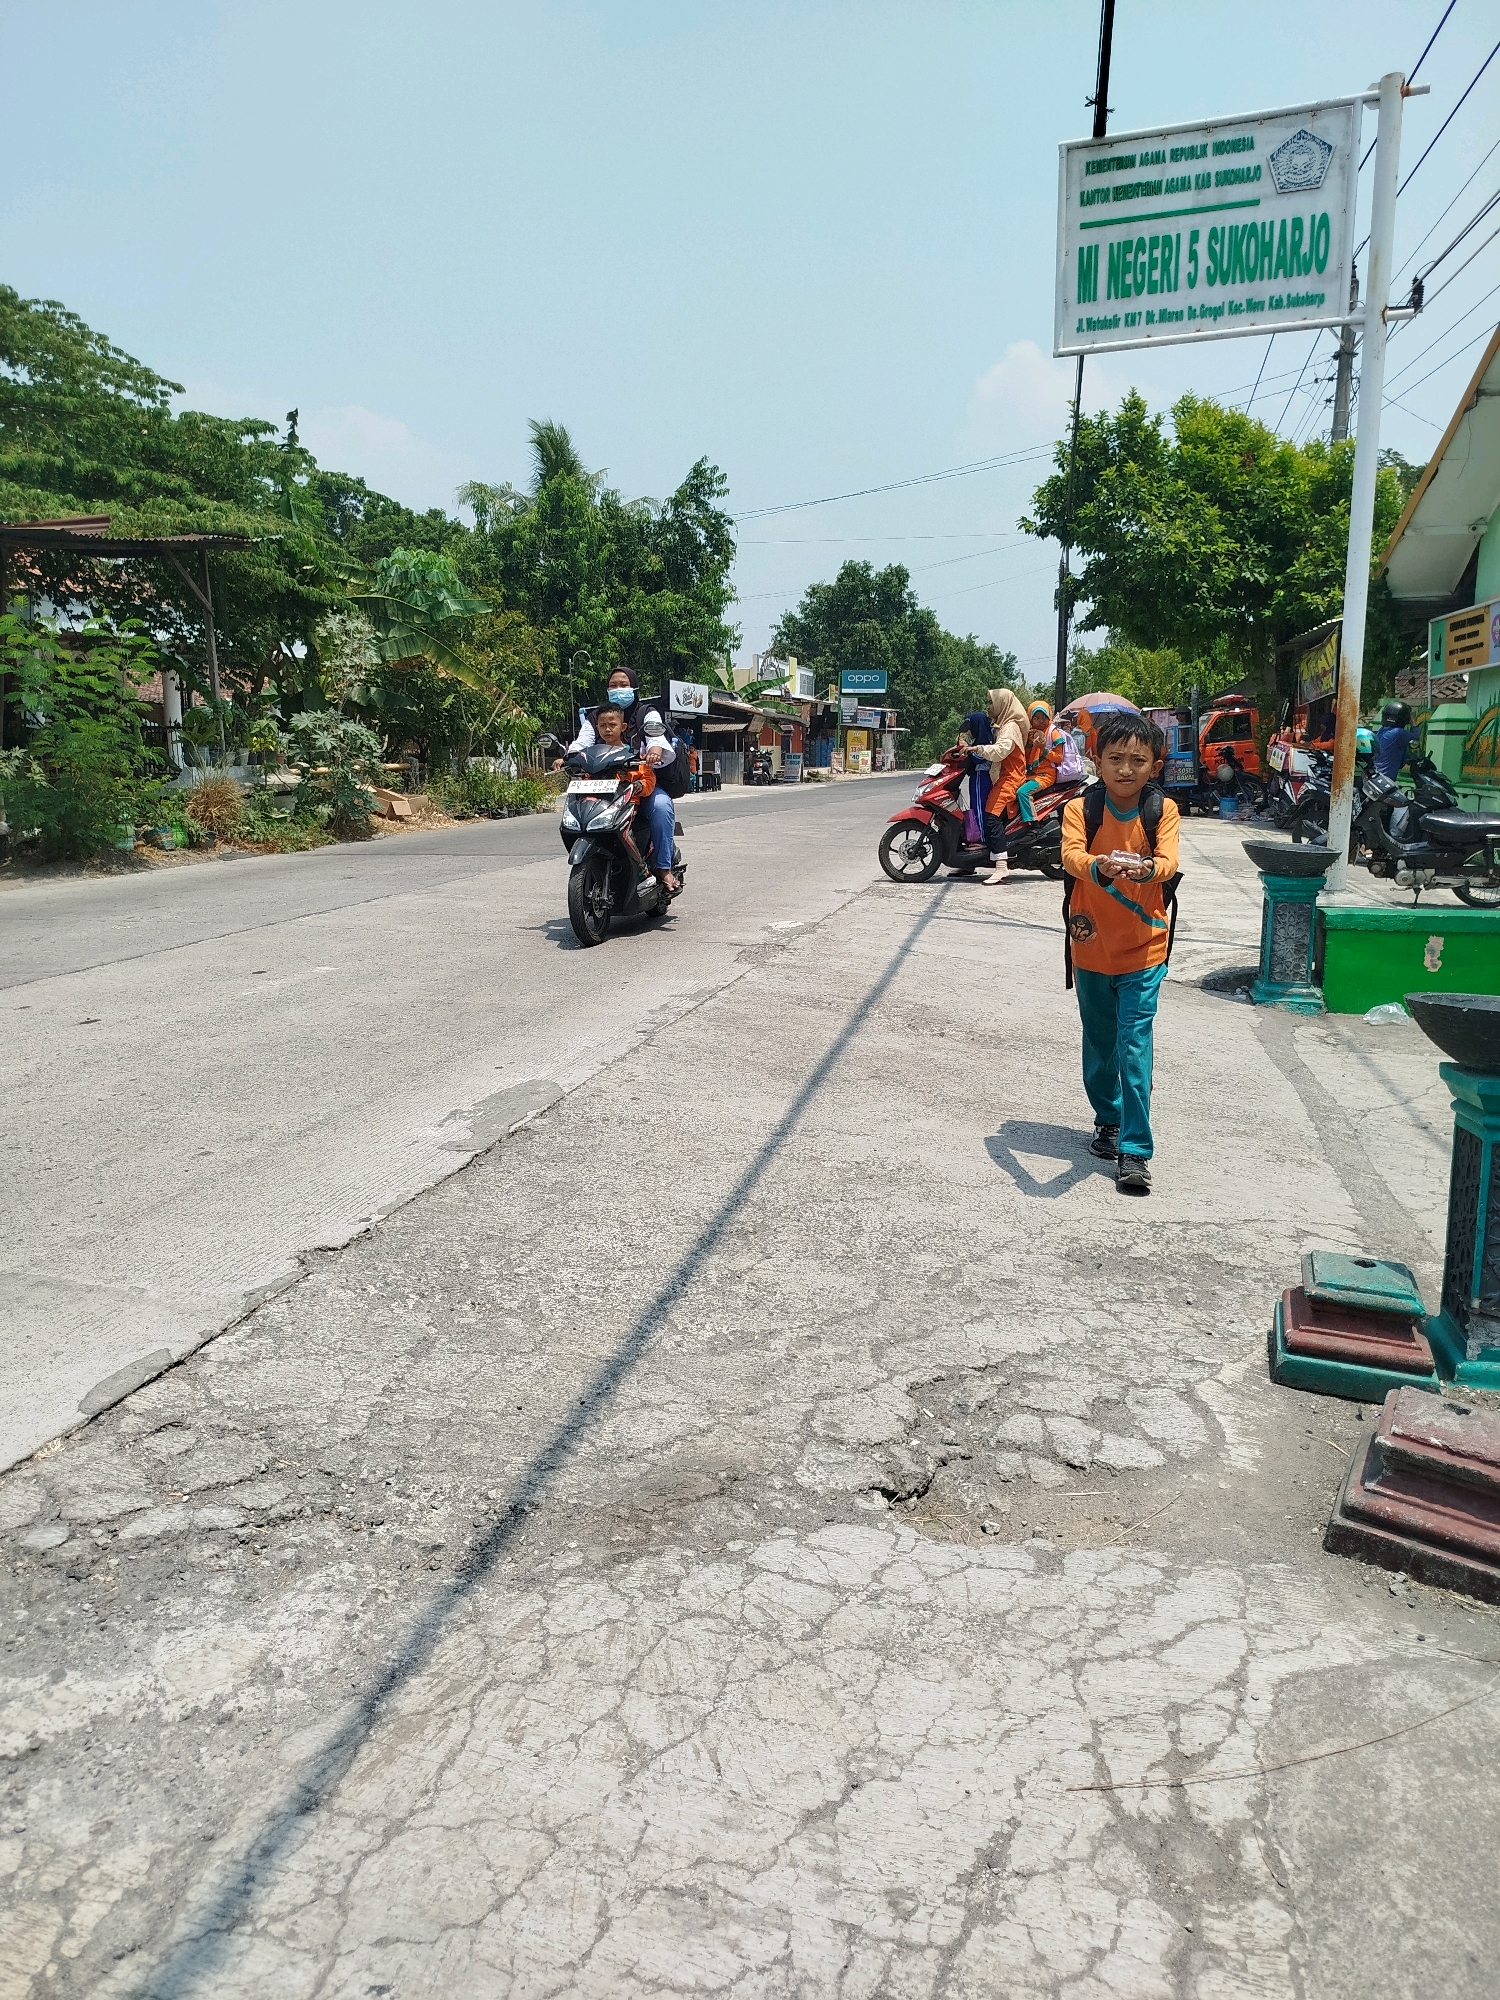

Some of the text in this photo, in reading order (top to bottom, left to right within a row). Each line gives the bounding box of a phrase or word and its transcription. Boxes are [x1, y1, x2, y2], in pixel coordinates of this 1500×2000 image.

[1139, 150, 1166, 167] AGAMA
[1169, 143, 1209, 162] REPUBLIK
[1212, 136, 1255, 156] INDONESIA
[1080, 186, 1111, 207] KANTOR
[1164, 175, 1192, 194] AGAMA
[1194, 171, 1212, 190] KAB
[1214, 164, 1262, 187] SUKOHARJO
[1077, 211, 1330, 304] MI NEGERI 5 SUKOHARJO
[847, 674, 880, 683] oppo
